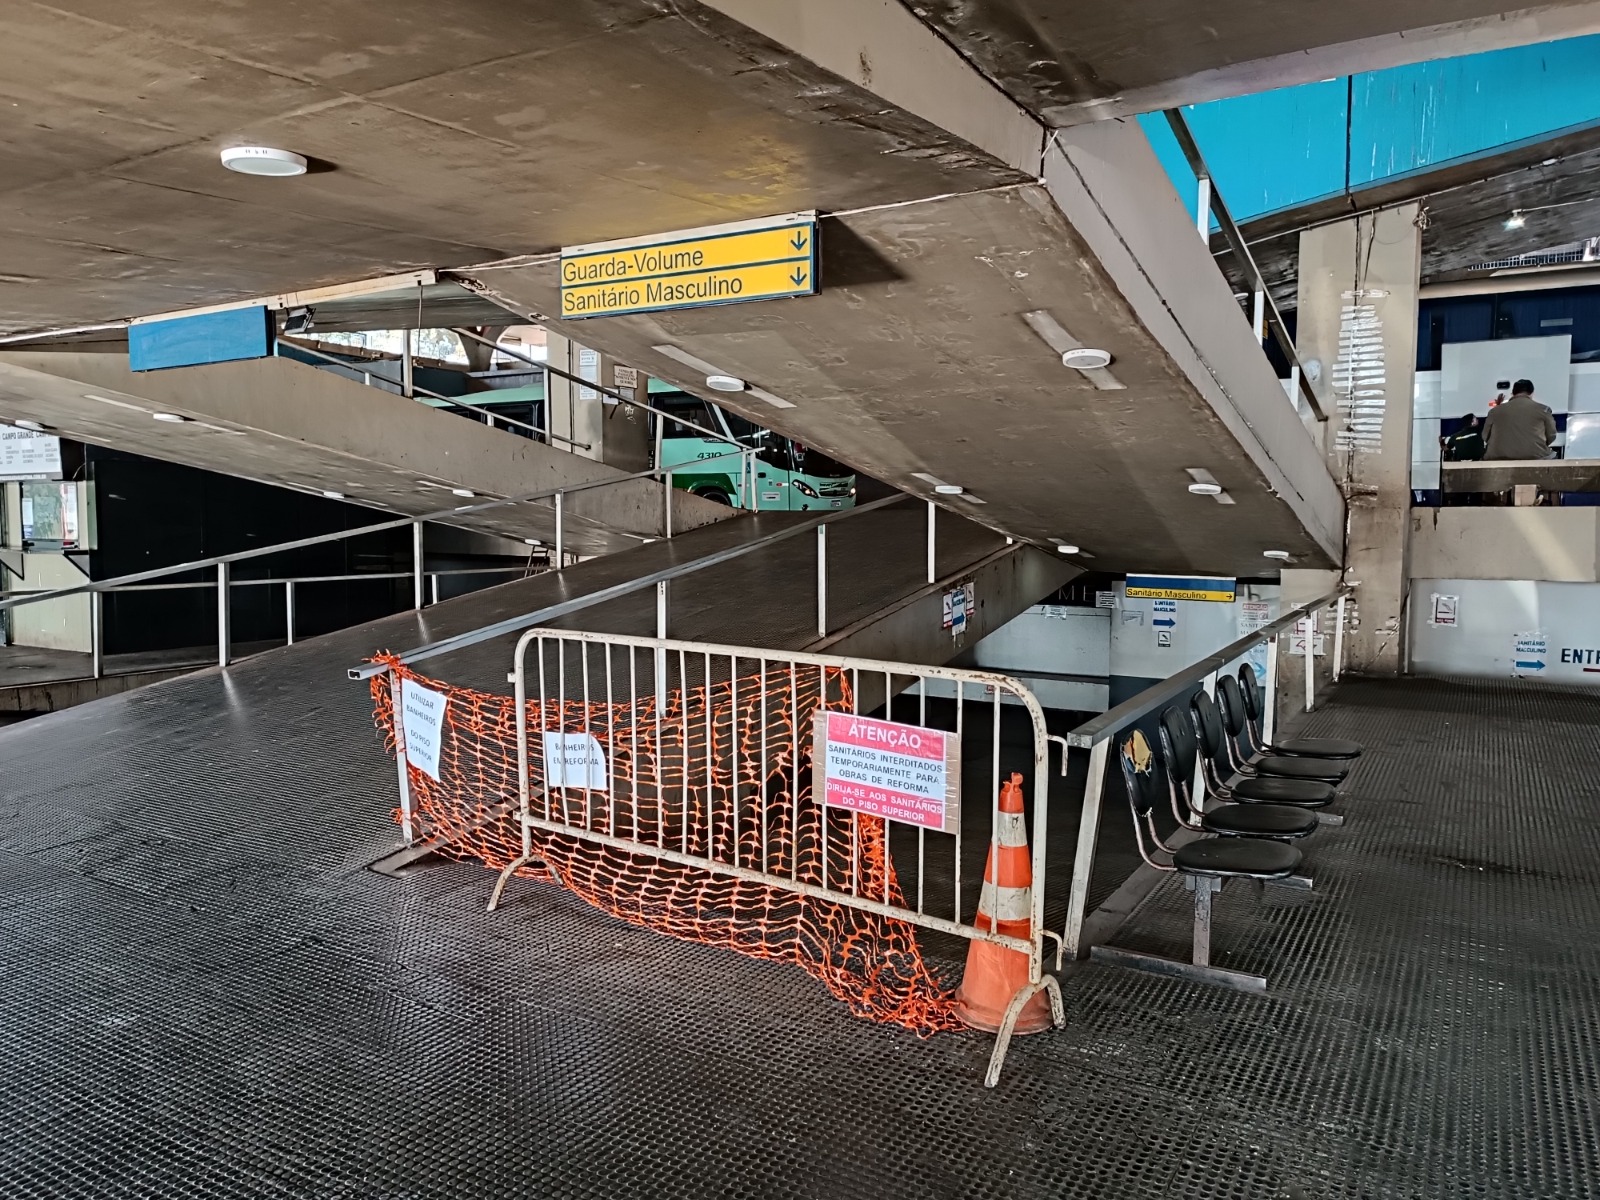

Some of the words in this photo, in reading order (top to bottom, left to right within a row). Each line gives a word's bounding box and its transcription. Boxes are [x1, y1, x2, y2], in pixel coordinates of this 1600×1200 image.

[563, 250, 703, 282] Guarda-Volume
[564, 287, 640, 311] Sanitário
[646, 275, 743, 303] Masculino
[2, 432, 16, 440] CAMPO
[1127, 588, 1162, 597] Sanitário
[1165, 590, 1207, 599] Masculino
[410, 691, 434, 710] UTILIZAR
[406, 704, 436, 726] BANHEIROS
[555, 743, 594, 751] BNHEIRS
[848, 723, 922, 749] ATENÇÃO
[828, 744, 876, 760] SANITÁRIOS
[880, 756, 943, 773] INTERDITADOS
[830, 756, 911, 779] TEMPORARIAMENTE
[916, 773, 940, 784] PARA
[839, 769, 867, 781] OBRAS
[871, 776, 882, 784] DE
[887, 779, 929, 794] REFORMA
[827, 782, 865, 797] DIRIJA-SE
[869, 791, 887, 801] AOS
[891, 796, 942, 813] SANITÁRIOS
[842, 797, 855, 805] DO
[859, 800, 878, 810] PISO
[882, 806, 925, 822] SUPERIOR
